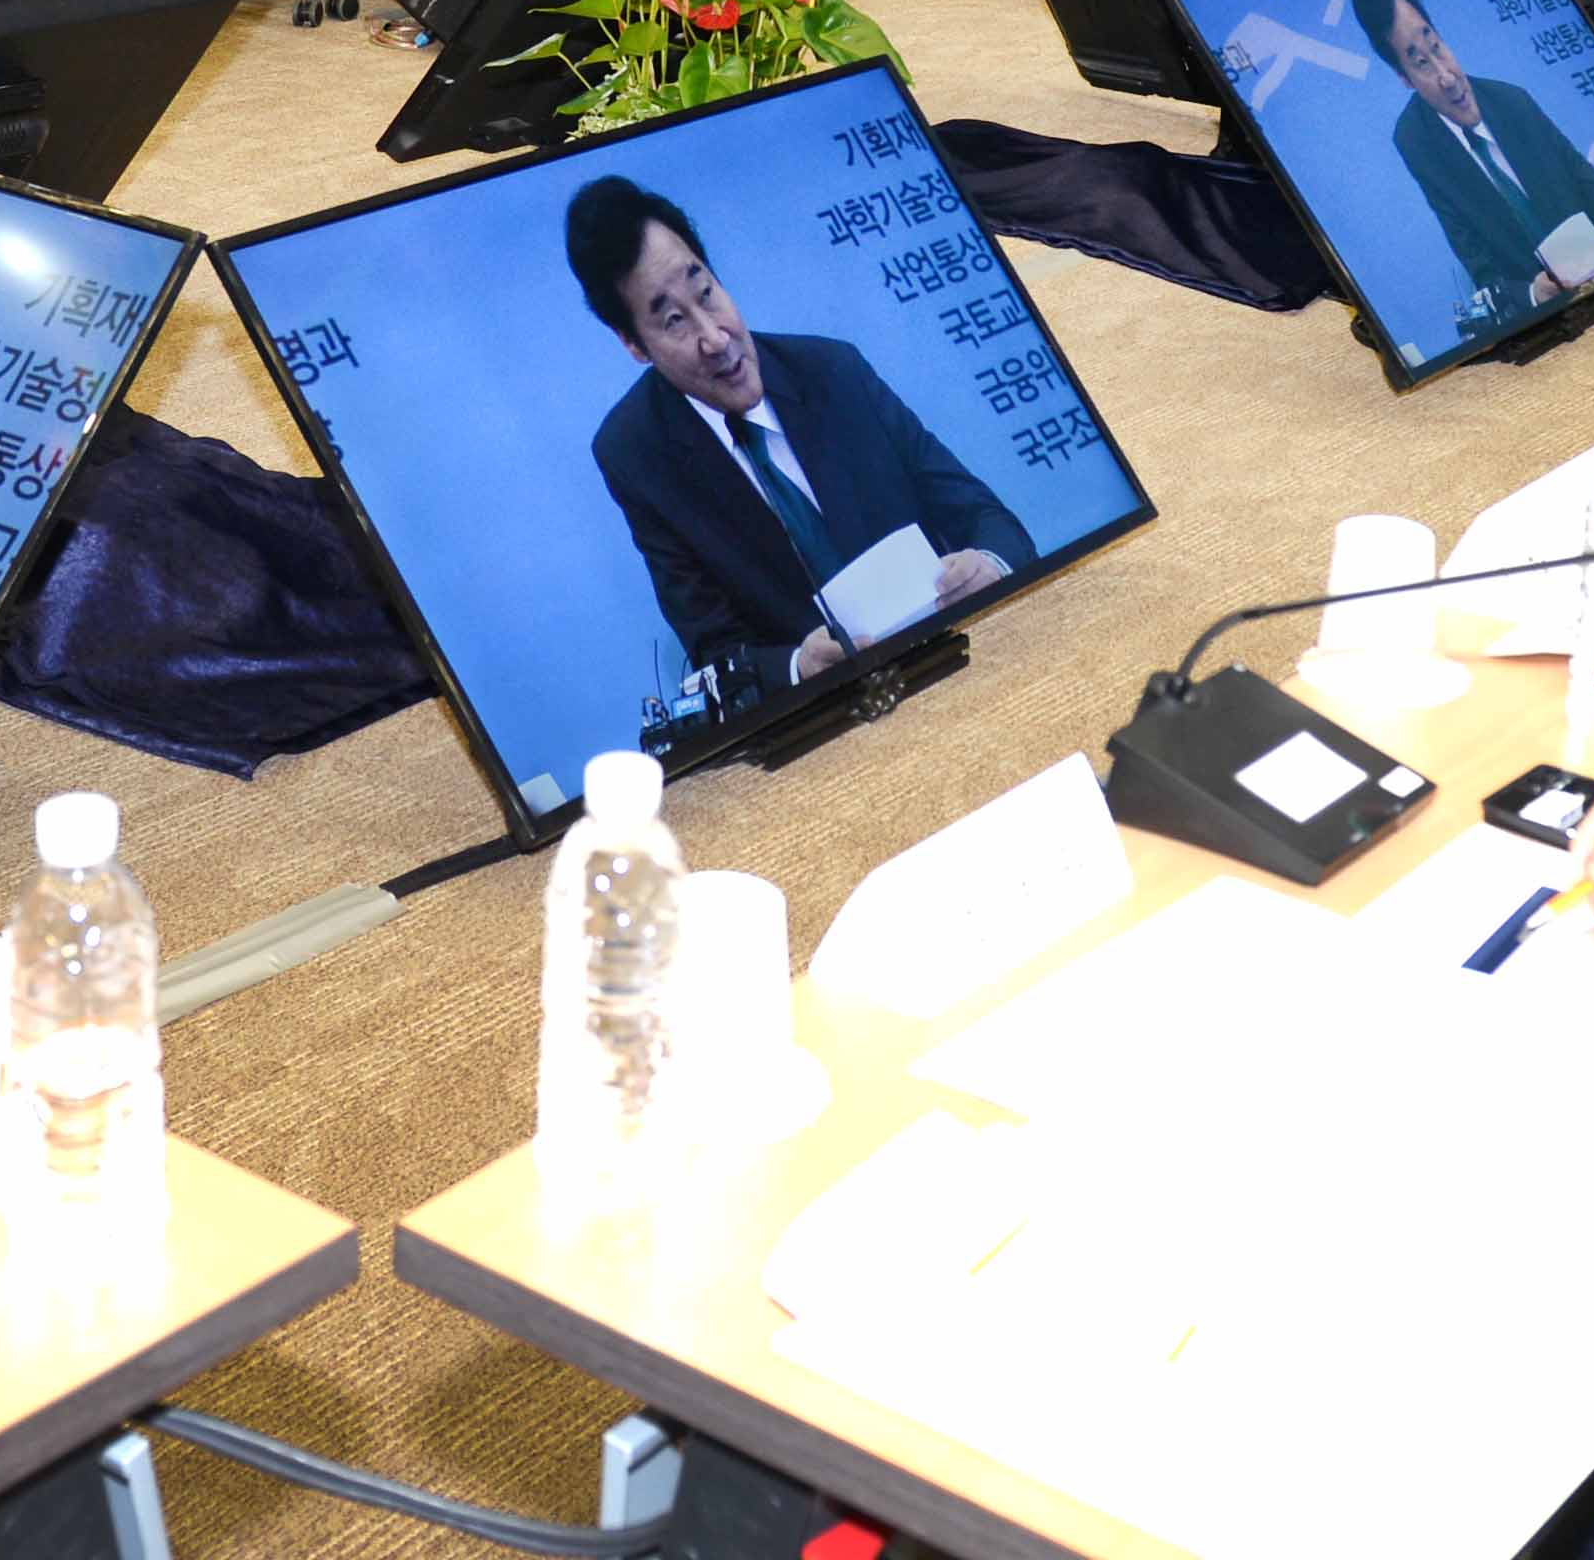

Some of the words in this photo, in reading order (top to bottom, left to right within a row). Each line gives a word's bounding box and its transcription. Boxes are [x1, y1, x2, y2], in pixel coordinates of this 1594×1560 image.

[833, 110, 929, 169] 기획재
[817, 168, 960, 247] 과학기술정
[880, 227, 993, 303] 산업통상
[938, 289, 1032, 350] 국토교
[975, 344, 1067, 414] 금융위
[1011, 407, 1103, 470] 국무조
